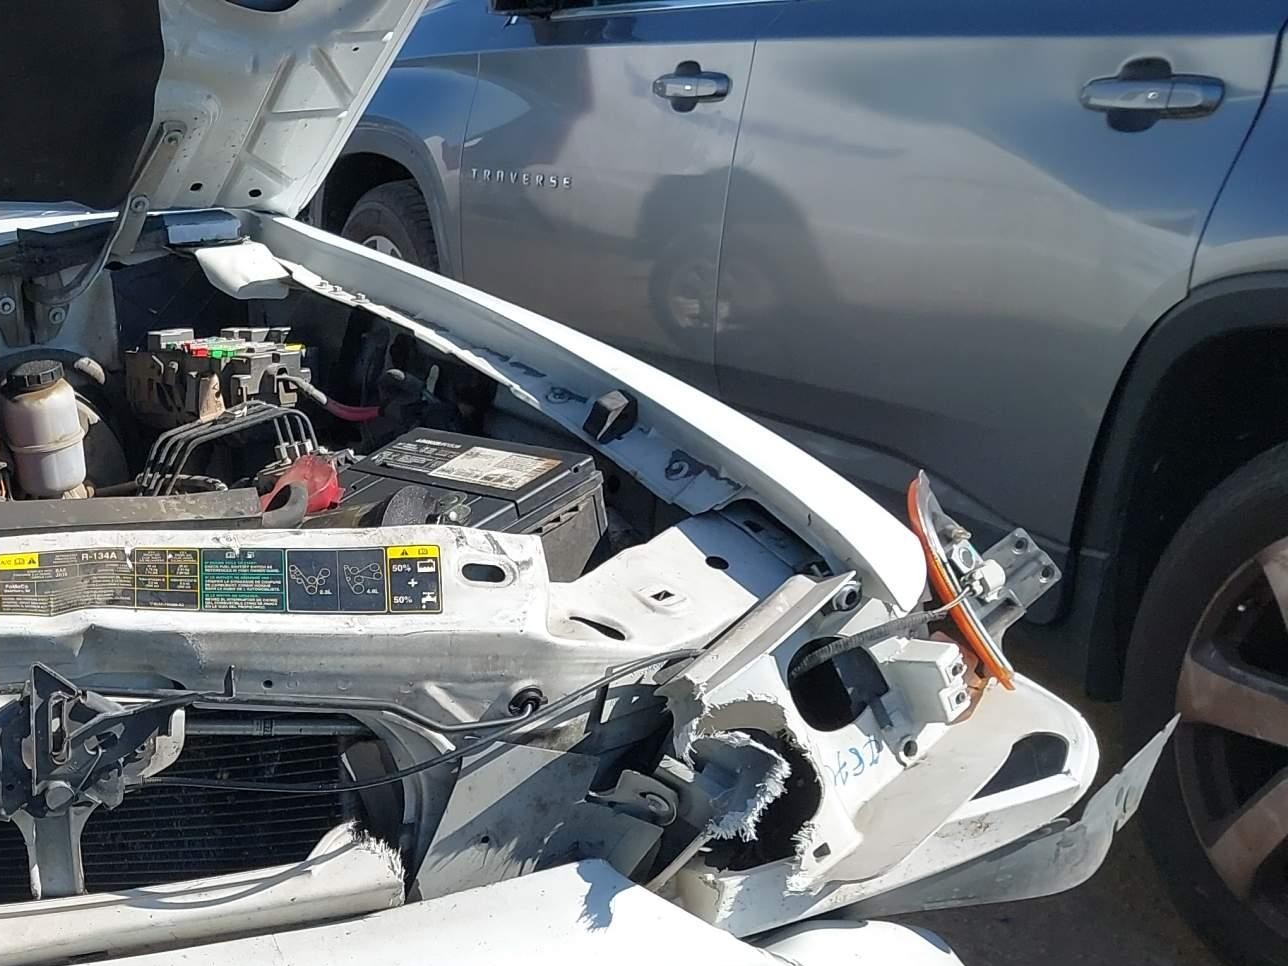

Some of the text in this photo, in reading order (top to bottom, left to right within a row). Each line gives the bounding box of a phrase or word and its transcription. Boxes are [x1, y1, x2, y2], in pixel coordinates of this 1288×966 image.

[471, 168, 572, 189] TRAVERSE
[81, 551, 117, 560] R-134A
[393, 596, 413, 604] 50%
